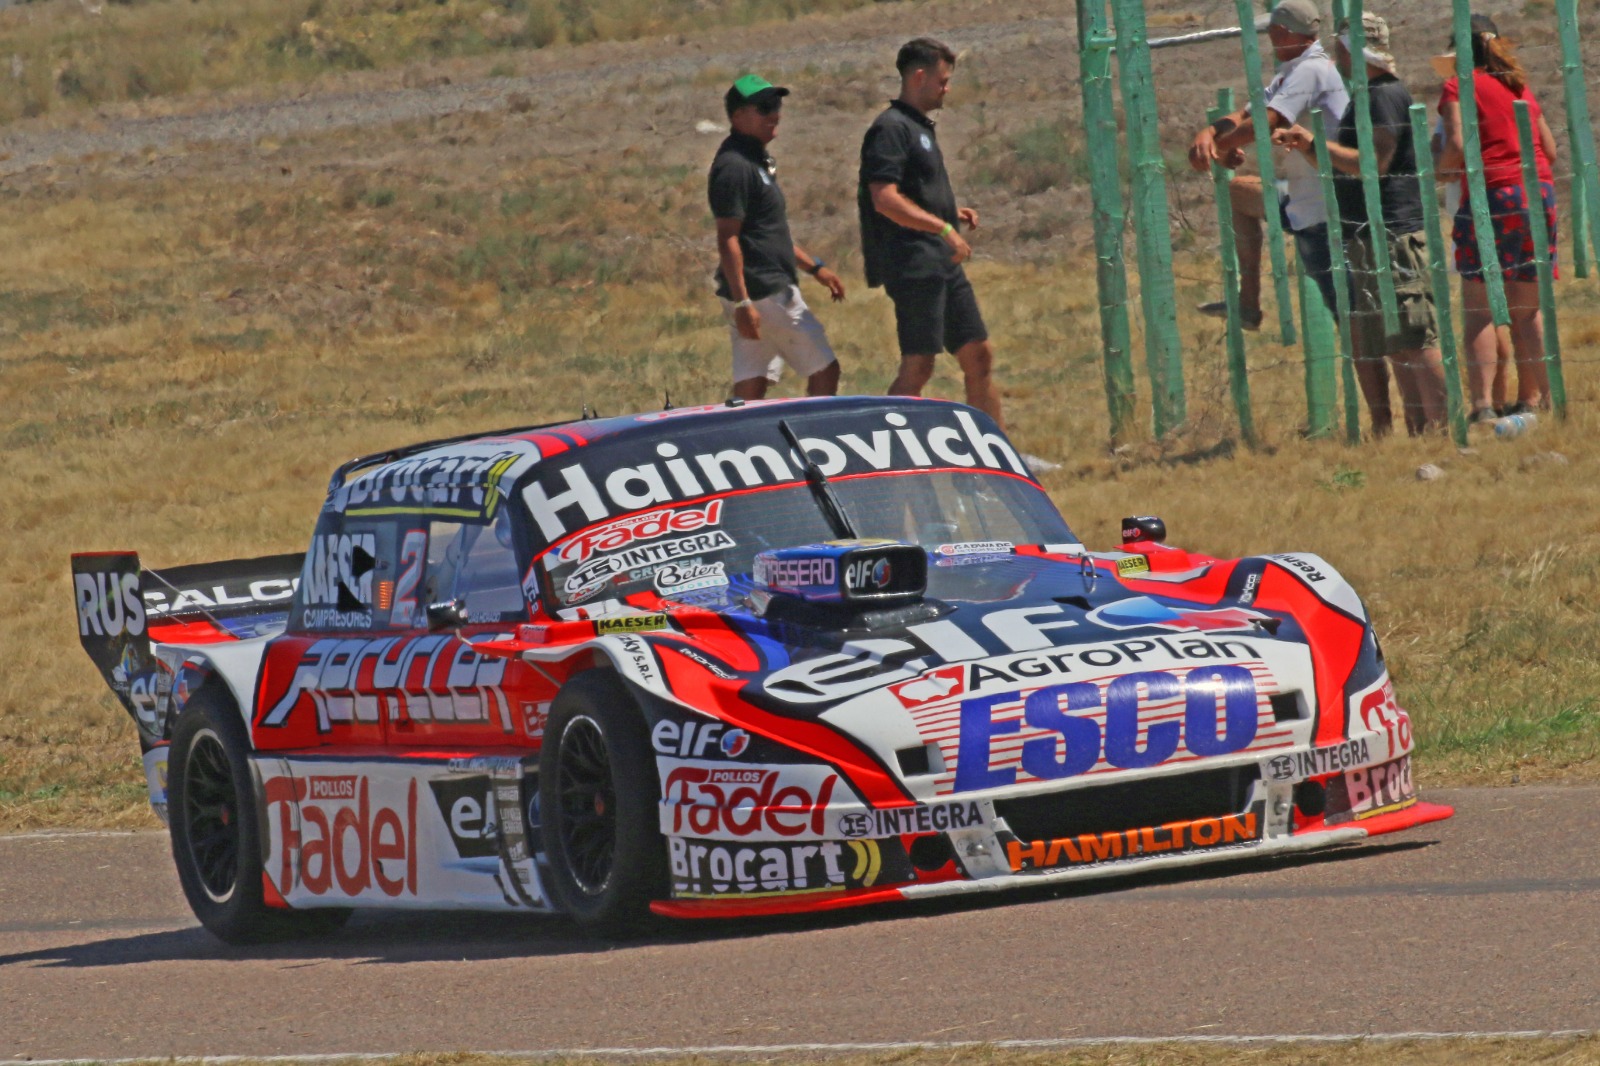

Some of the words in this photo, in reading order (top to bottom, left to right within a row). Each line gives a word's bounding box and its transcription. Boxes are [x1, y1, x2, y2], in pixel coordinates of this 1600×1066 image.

[522, 409, 1029, 544] Haimovich
[560, 501, 720, 562] Fadel
[622, 533, 732, 567] INTEGRA
[662, 578, 728, 595] DEPORTES
[845, 559, 874, 589] elf
[74, 571, 146, 637] RUS
[600, 614, 665, 630] KAESER
[762, 605, 1079, 702] elf
[651, 719, 723, 757] elf
[953, 664, 1259, 793] ESCO
[713, 771, 760, 784] POLLOS
[1298, 738, 1370, 777] INTEGRA
[313, 780, 353, 797] POLLOS
[664, 766, 838, 837] Fadel
[264, 775, 418, 898] Fadel
[875, 803, 984, 836] INTEGRA
[1006, 812, 1258, 873] HAMILTON
[669, 836, 846, 892] Brocart
